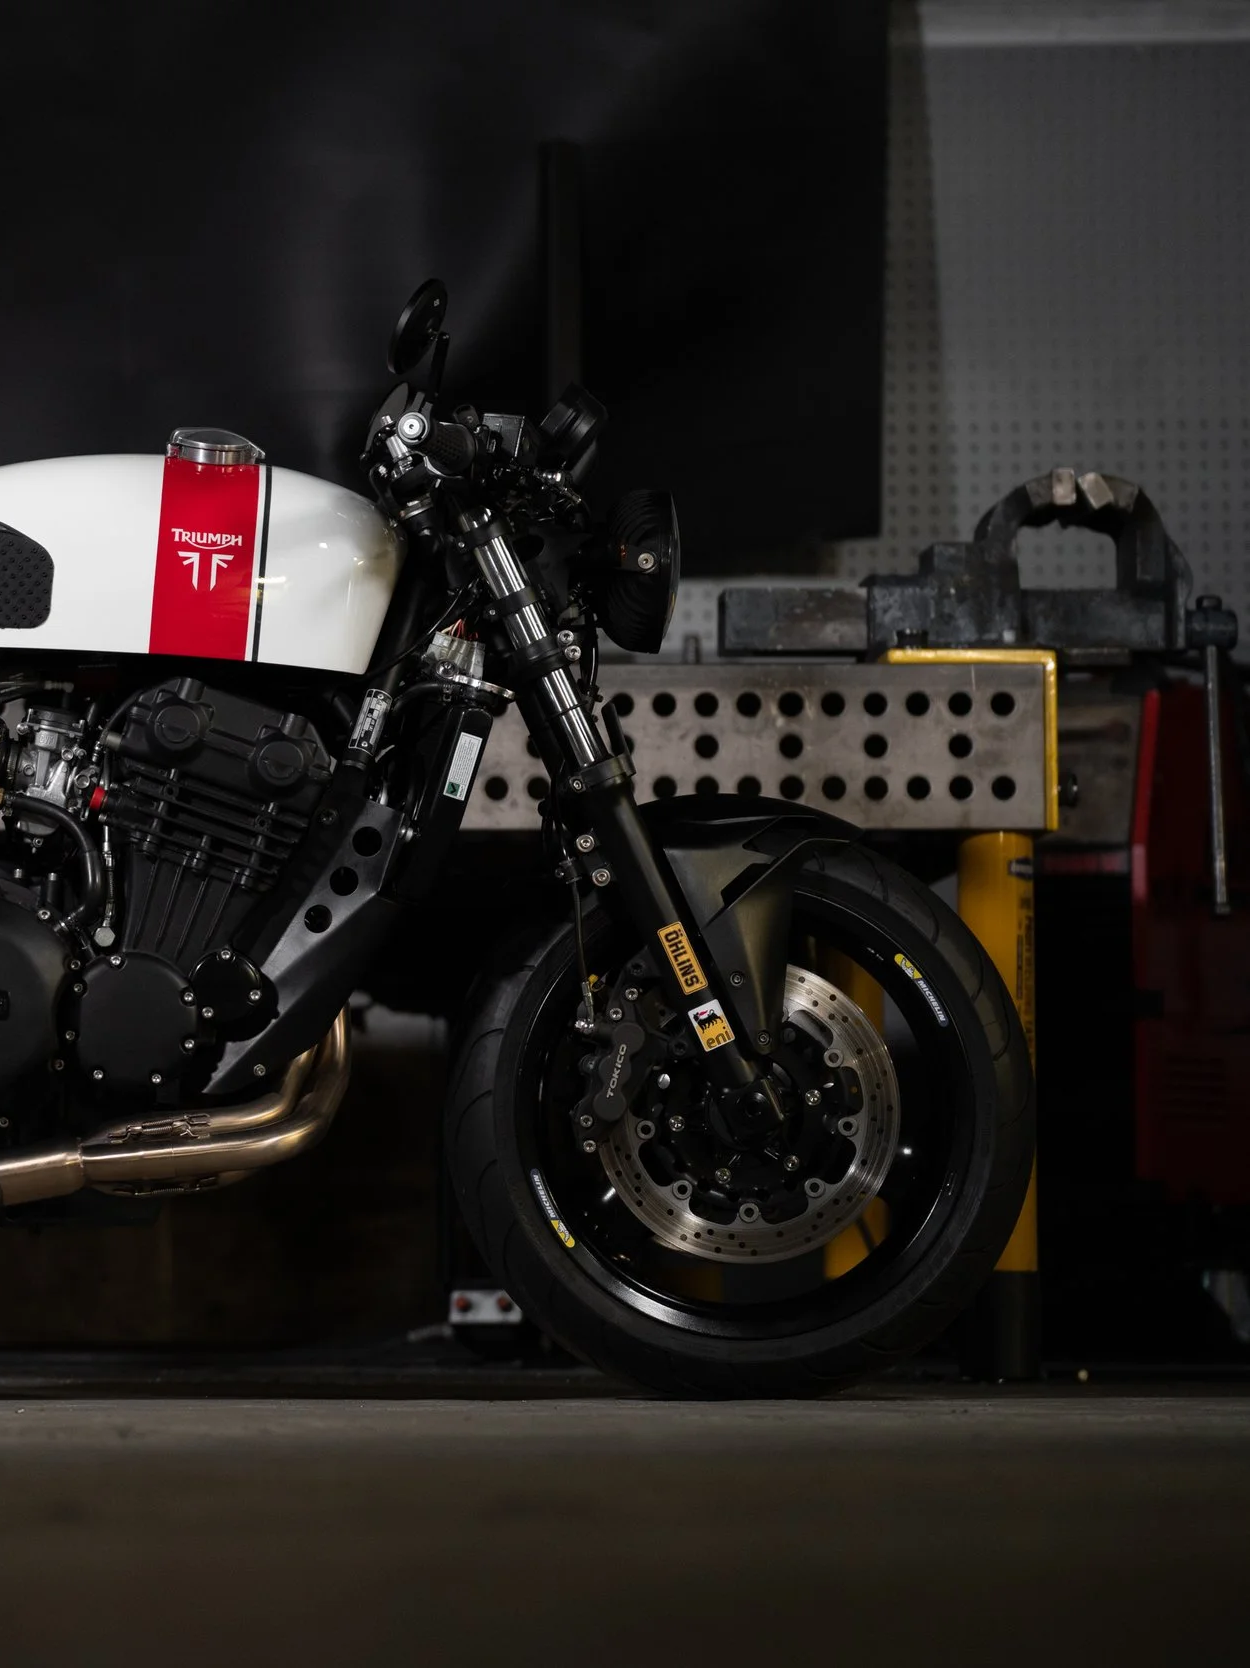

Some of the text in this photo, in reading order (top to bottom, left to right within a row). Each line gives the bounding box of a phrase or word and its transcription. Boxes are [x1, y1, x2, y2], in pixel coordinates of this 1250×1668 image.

[171, 528, 242, 549] TRIUMPH
[664, 928, 699, 987] ÖHLINS
[917, 980, 946, 1022] MICHELIN
[706, 1027, 731, 1049] eni
[606, 1043, 627, 1098] TOKICO
[533, 1174, 556, 1218] MICHELIN
